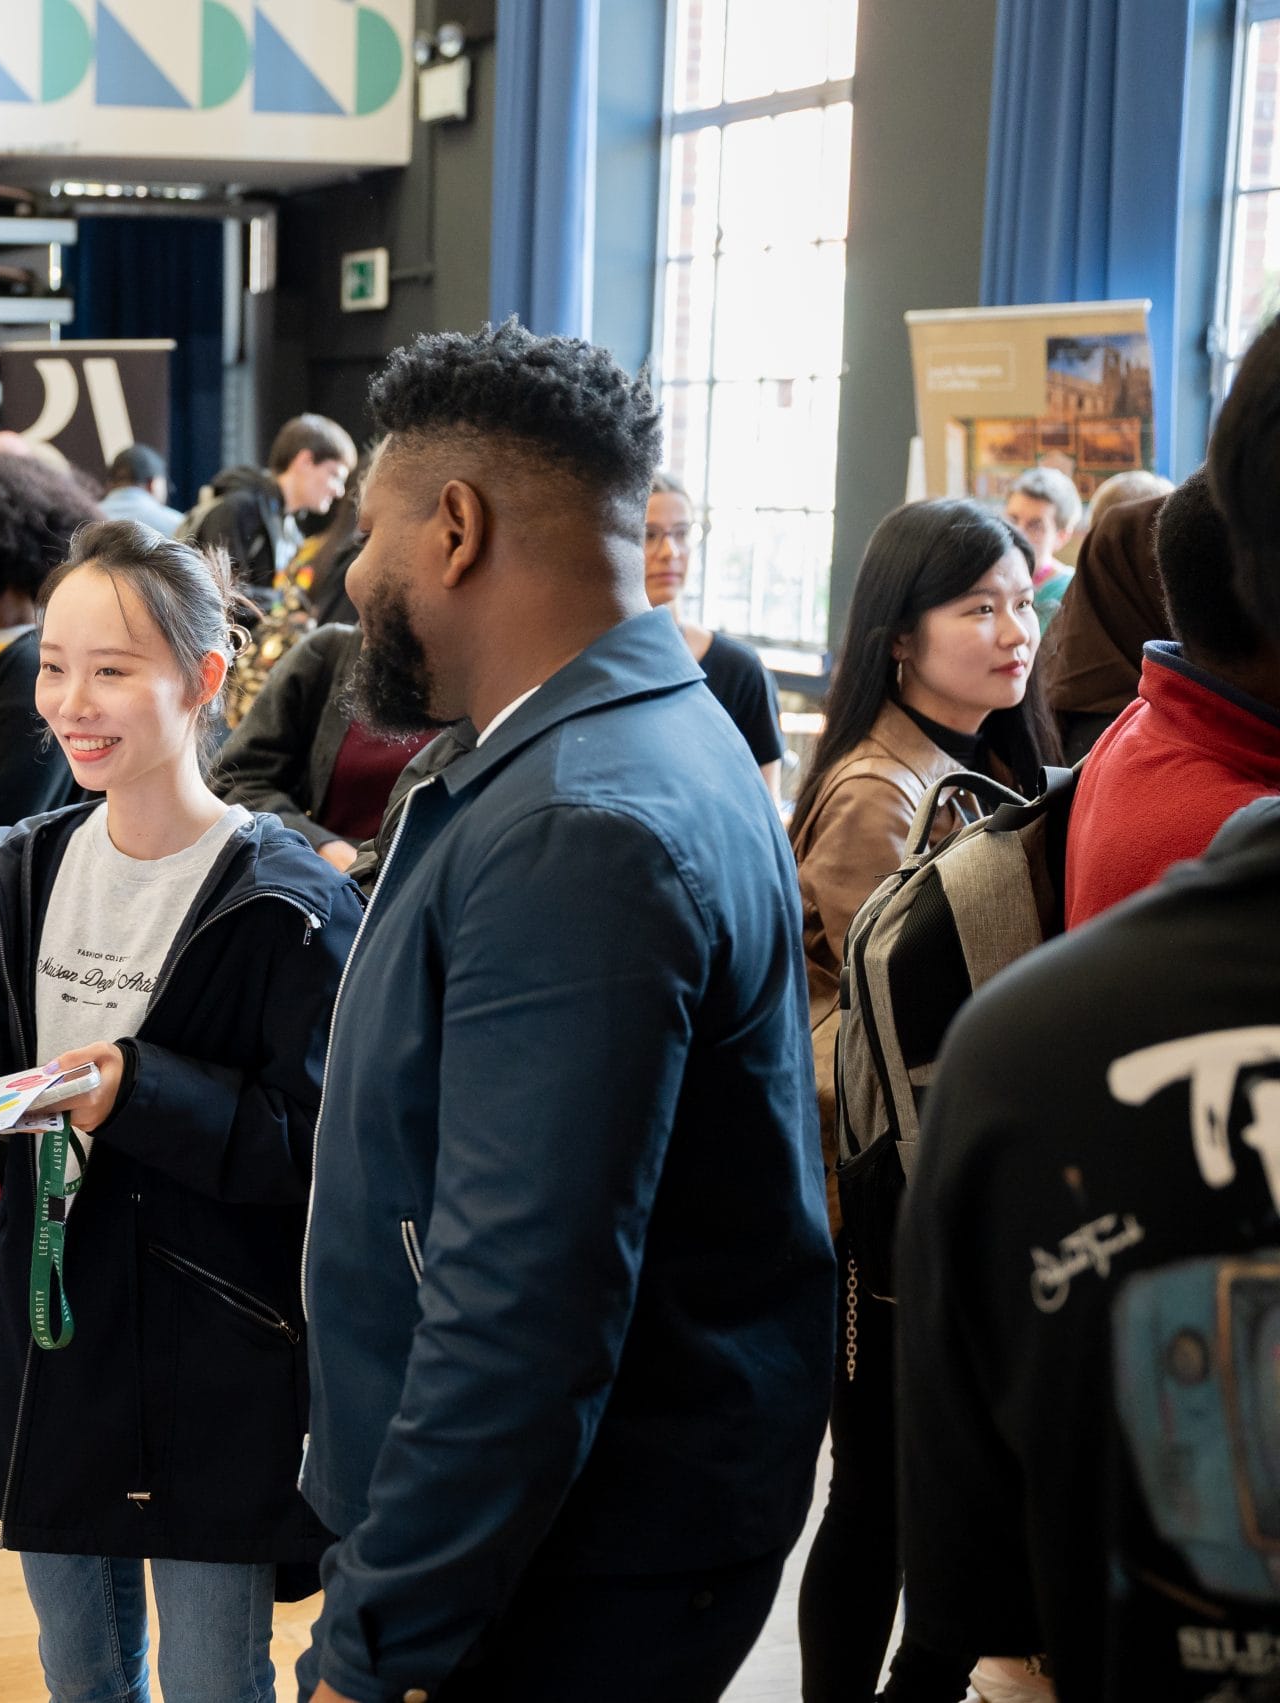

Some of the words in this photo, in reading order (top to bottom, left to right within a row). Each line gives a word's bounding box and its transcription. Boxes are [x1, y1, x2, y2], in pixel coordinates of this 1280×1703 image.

[77, 949, 103, 959] FASHION
[39, 1226, 49, 1256] LEEDS
[35, 1290, 45, 1332] VARSITY
